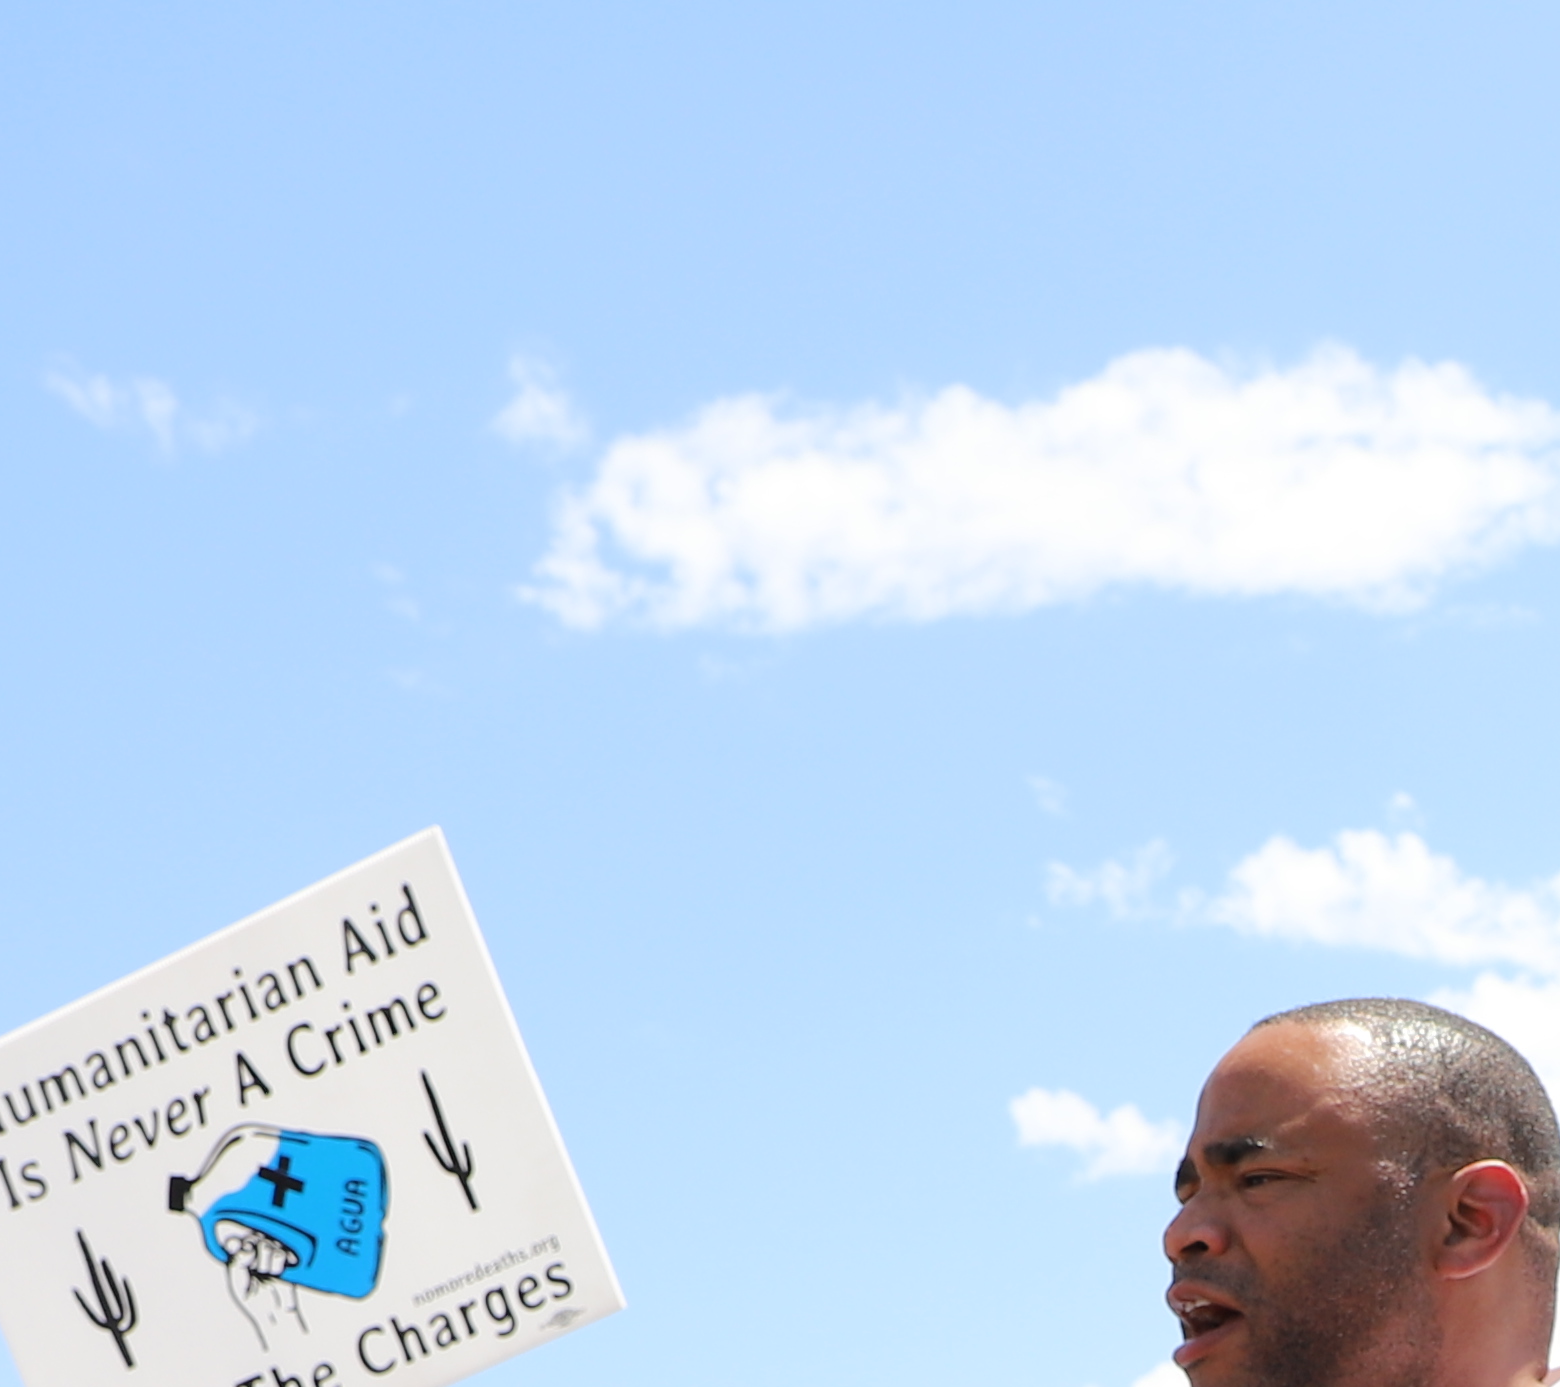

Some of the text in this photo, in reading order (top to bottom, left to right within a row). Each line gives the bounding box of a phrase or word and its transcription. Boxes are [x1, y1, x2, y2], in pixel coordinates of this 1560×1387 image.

[338, 882, 430, 976] Aid
[63, 1085, 212, 1185] Never
[235, 1050, 271, 1107] A
[285, 979, 447, 1077] Crime
[336, 1177, 369, 1257] AGUA
[355, 1259, 577, 1376] Charges
